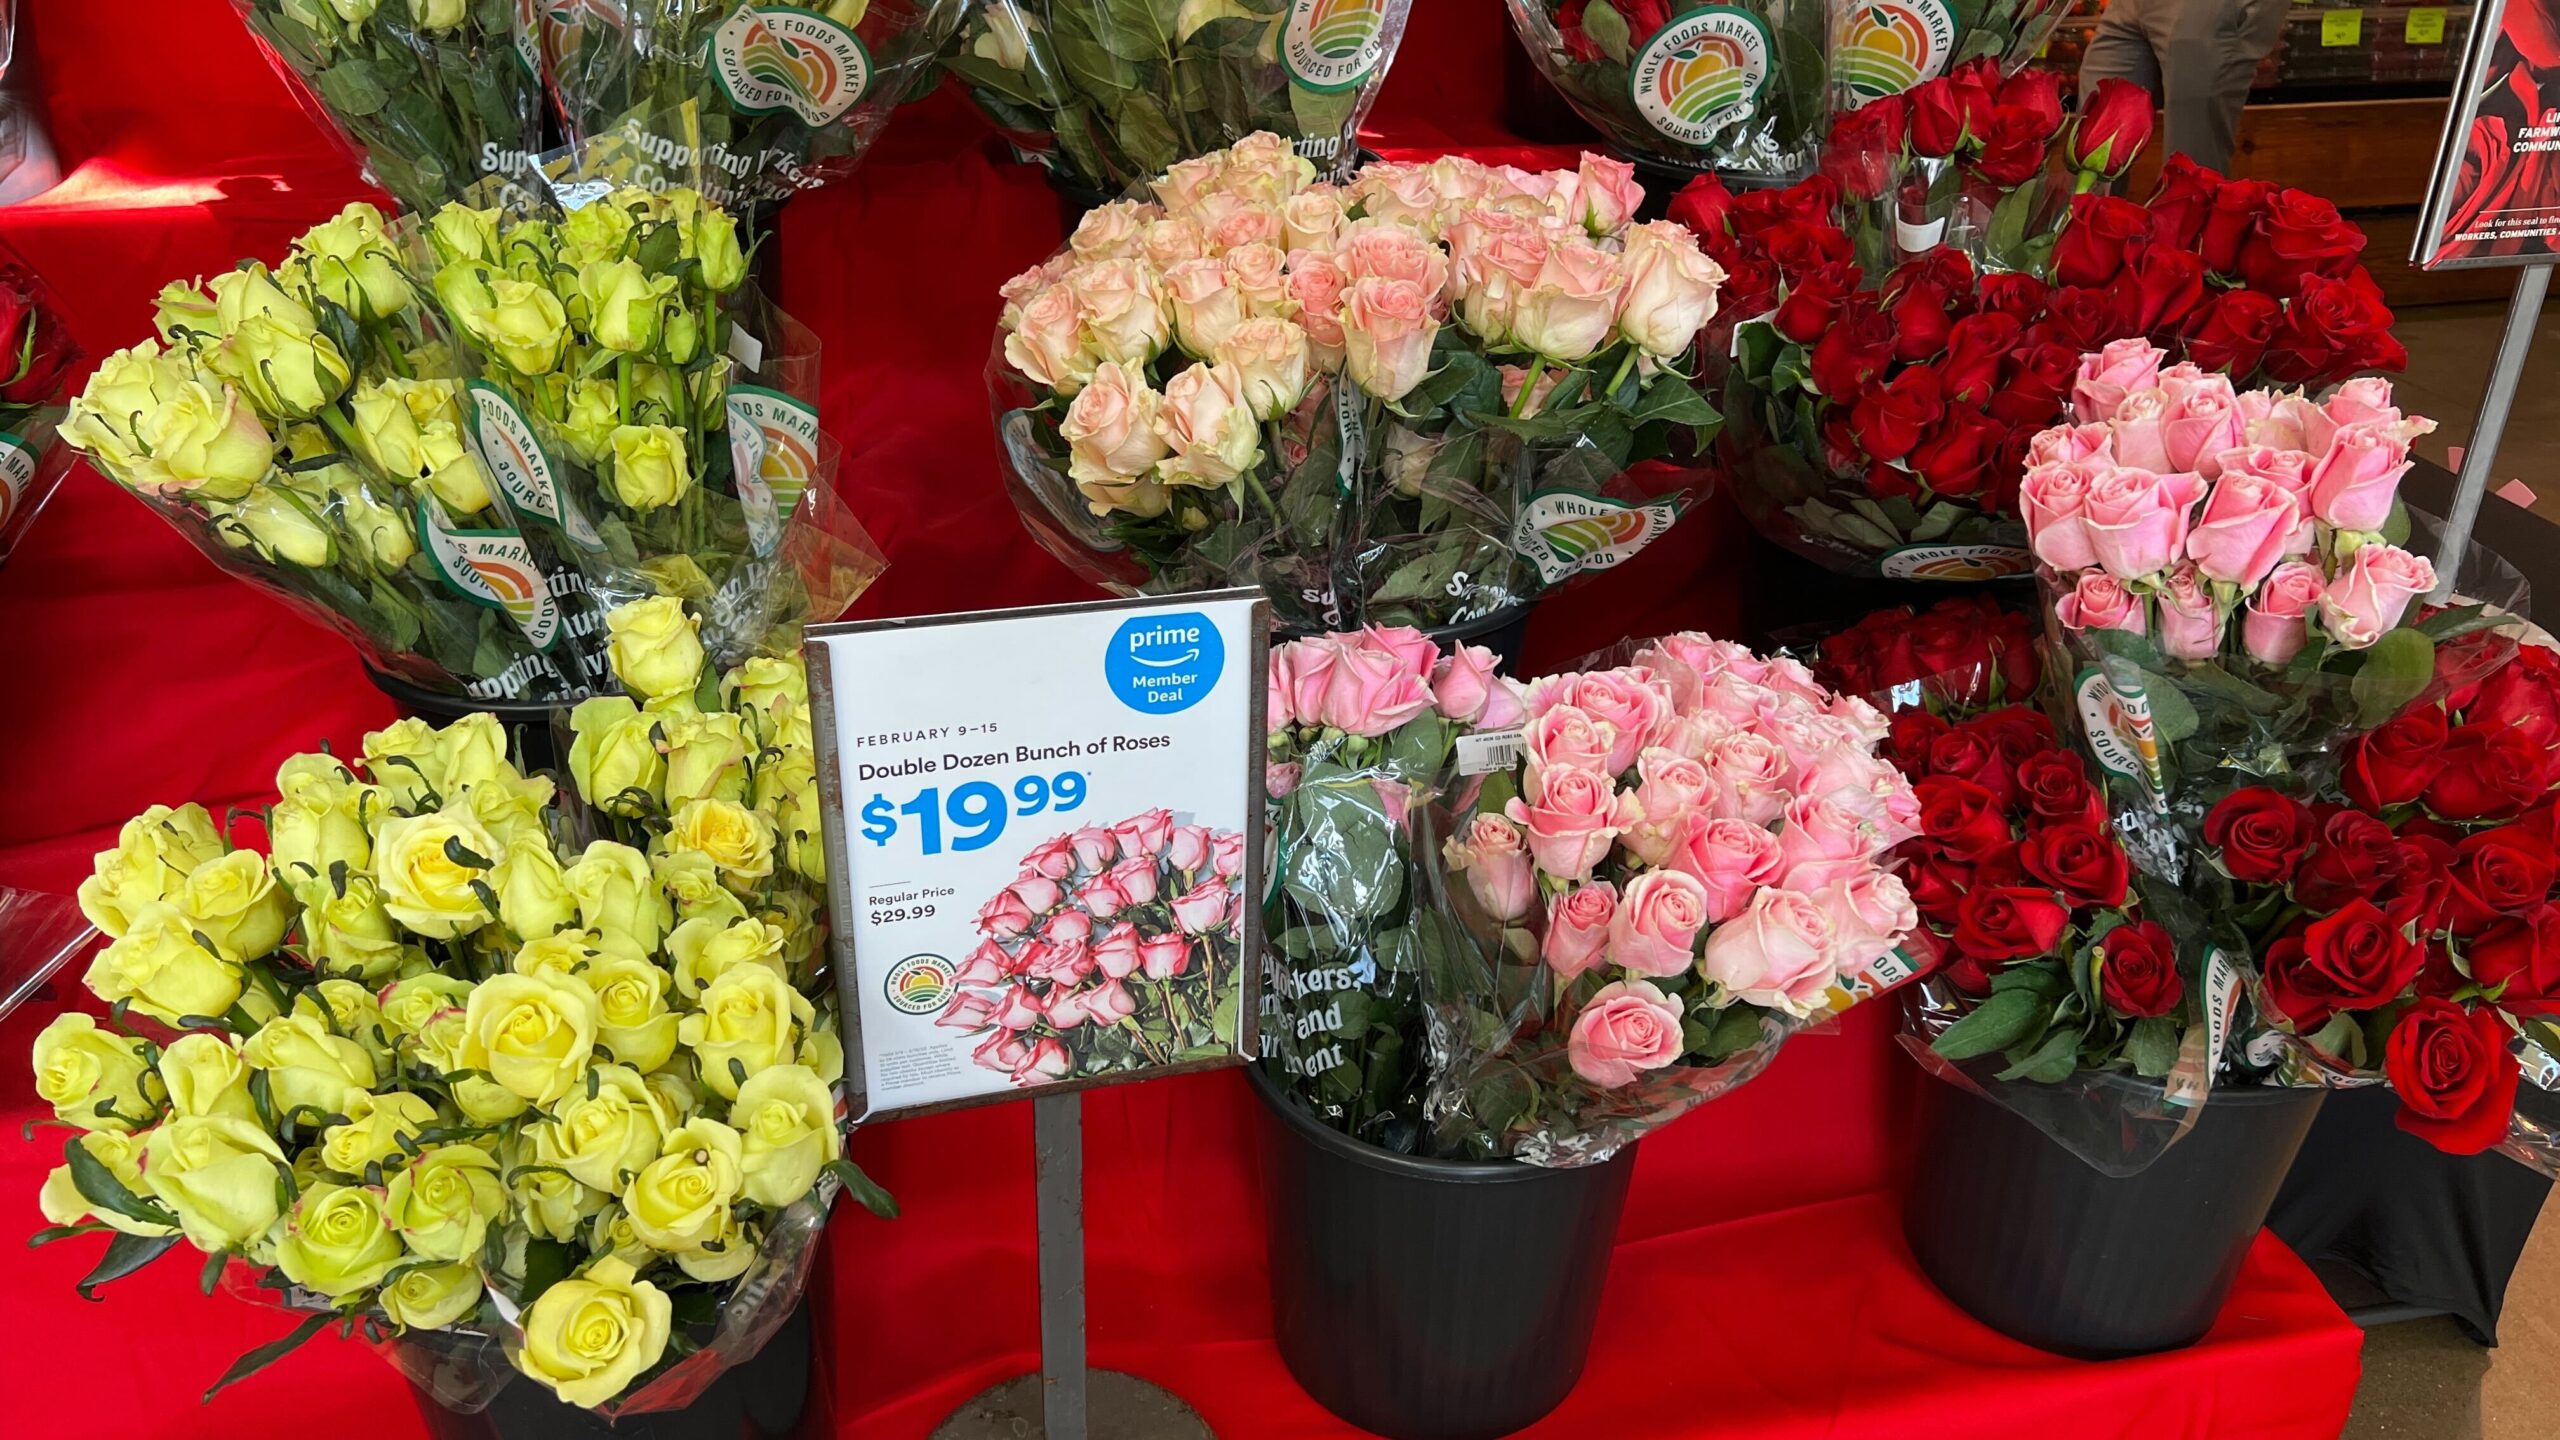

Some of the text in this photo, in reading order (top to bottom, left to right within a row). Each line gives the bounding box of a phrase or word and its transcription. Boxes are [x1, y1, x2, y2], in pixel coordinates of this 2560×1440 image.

[1917, 0, 1948, 52] MARKET
[784, 20, 836, 44] FOODS
[834, 44, 860, 94] MARKET
[1292, 41, 1333, 78] SOURCED
[1337, 58, 1362, 78] FOR
[1640, 20, 1759, 95] WHOLE FOODS MARKET
[722, 47, 762, 102] SOURCED
[1656, 116, 1713, 140] SOURCED
[2518, 126, 2560, 139] FARMW
[2513, 140, 2560, 152] COMMUN
[2474, 215, 2560, 229] Look for this seal to fin
[2454, 227, 2558, 241] WORKERS, COMMUNITIES
[1555, 501, 1609, 516] WHOLE
[1906, 549, 1960, 562] WHOLE
[1546, 566, 1571, 579] FOR
[1129, 625, 1200, 653] prime
[1133, 673, 1198, 689] Member
[1147, 688, 1184, 704] Deal
[857, 727, 950, 748] FEBRUARY
[858, 732, 1171, 781] Double Dozen Bunch of Roses
[868, 887, 955, 907] Regular Price
[870, 904, 936, 926] $29.99
[1297, 1000, 1344, 1040] and
